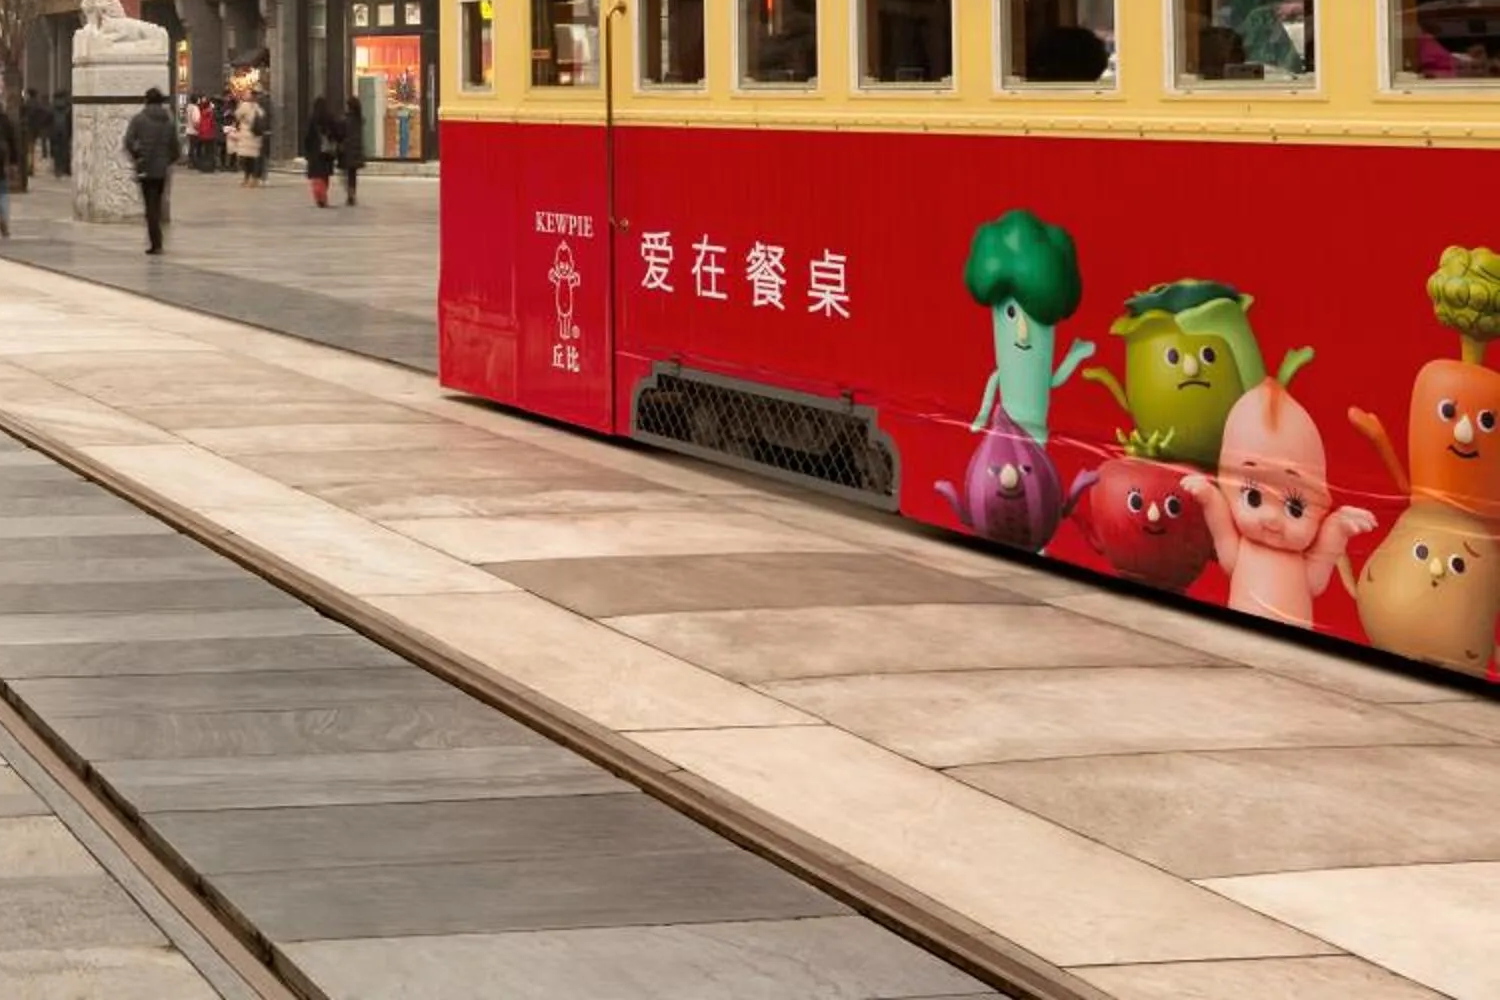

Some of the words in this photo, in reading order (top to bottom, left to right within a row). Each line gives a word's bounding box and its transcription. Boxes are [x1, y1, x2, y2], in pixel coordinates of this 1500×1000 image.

[535, 211, 594, 238] KEWPIE
[640, 231, 850, 319] 爱在餐桌
[551, 343, 580, 373] 丘比
